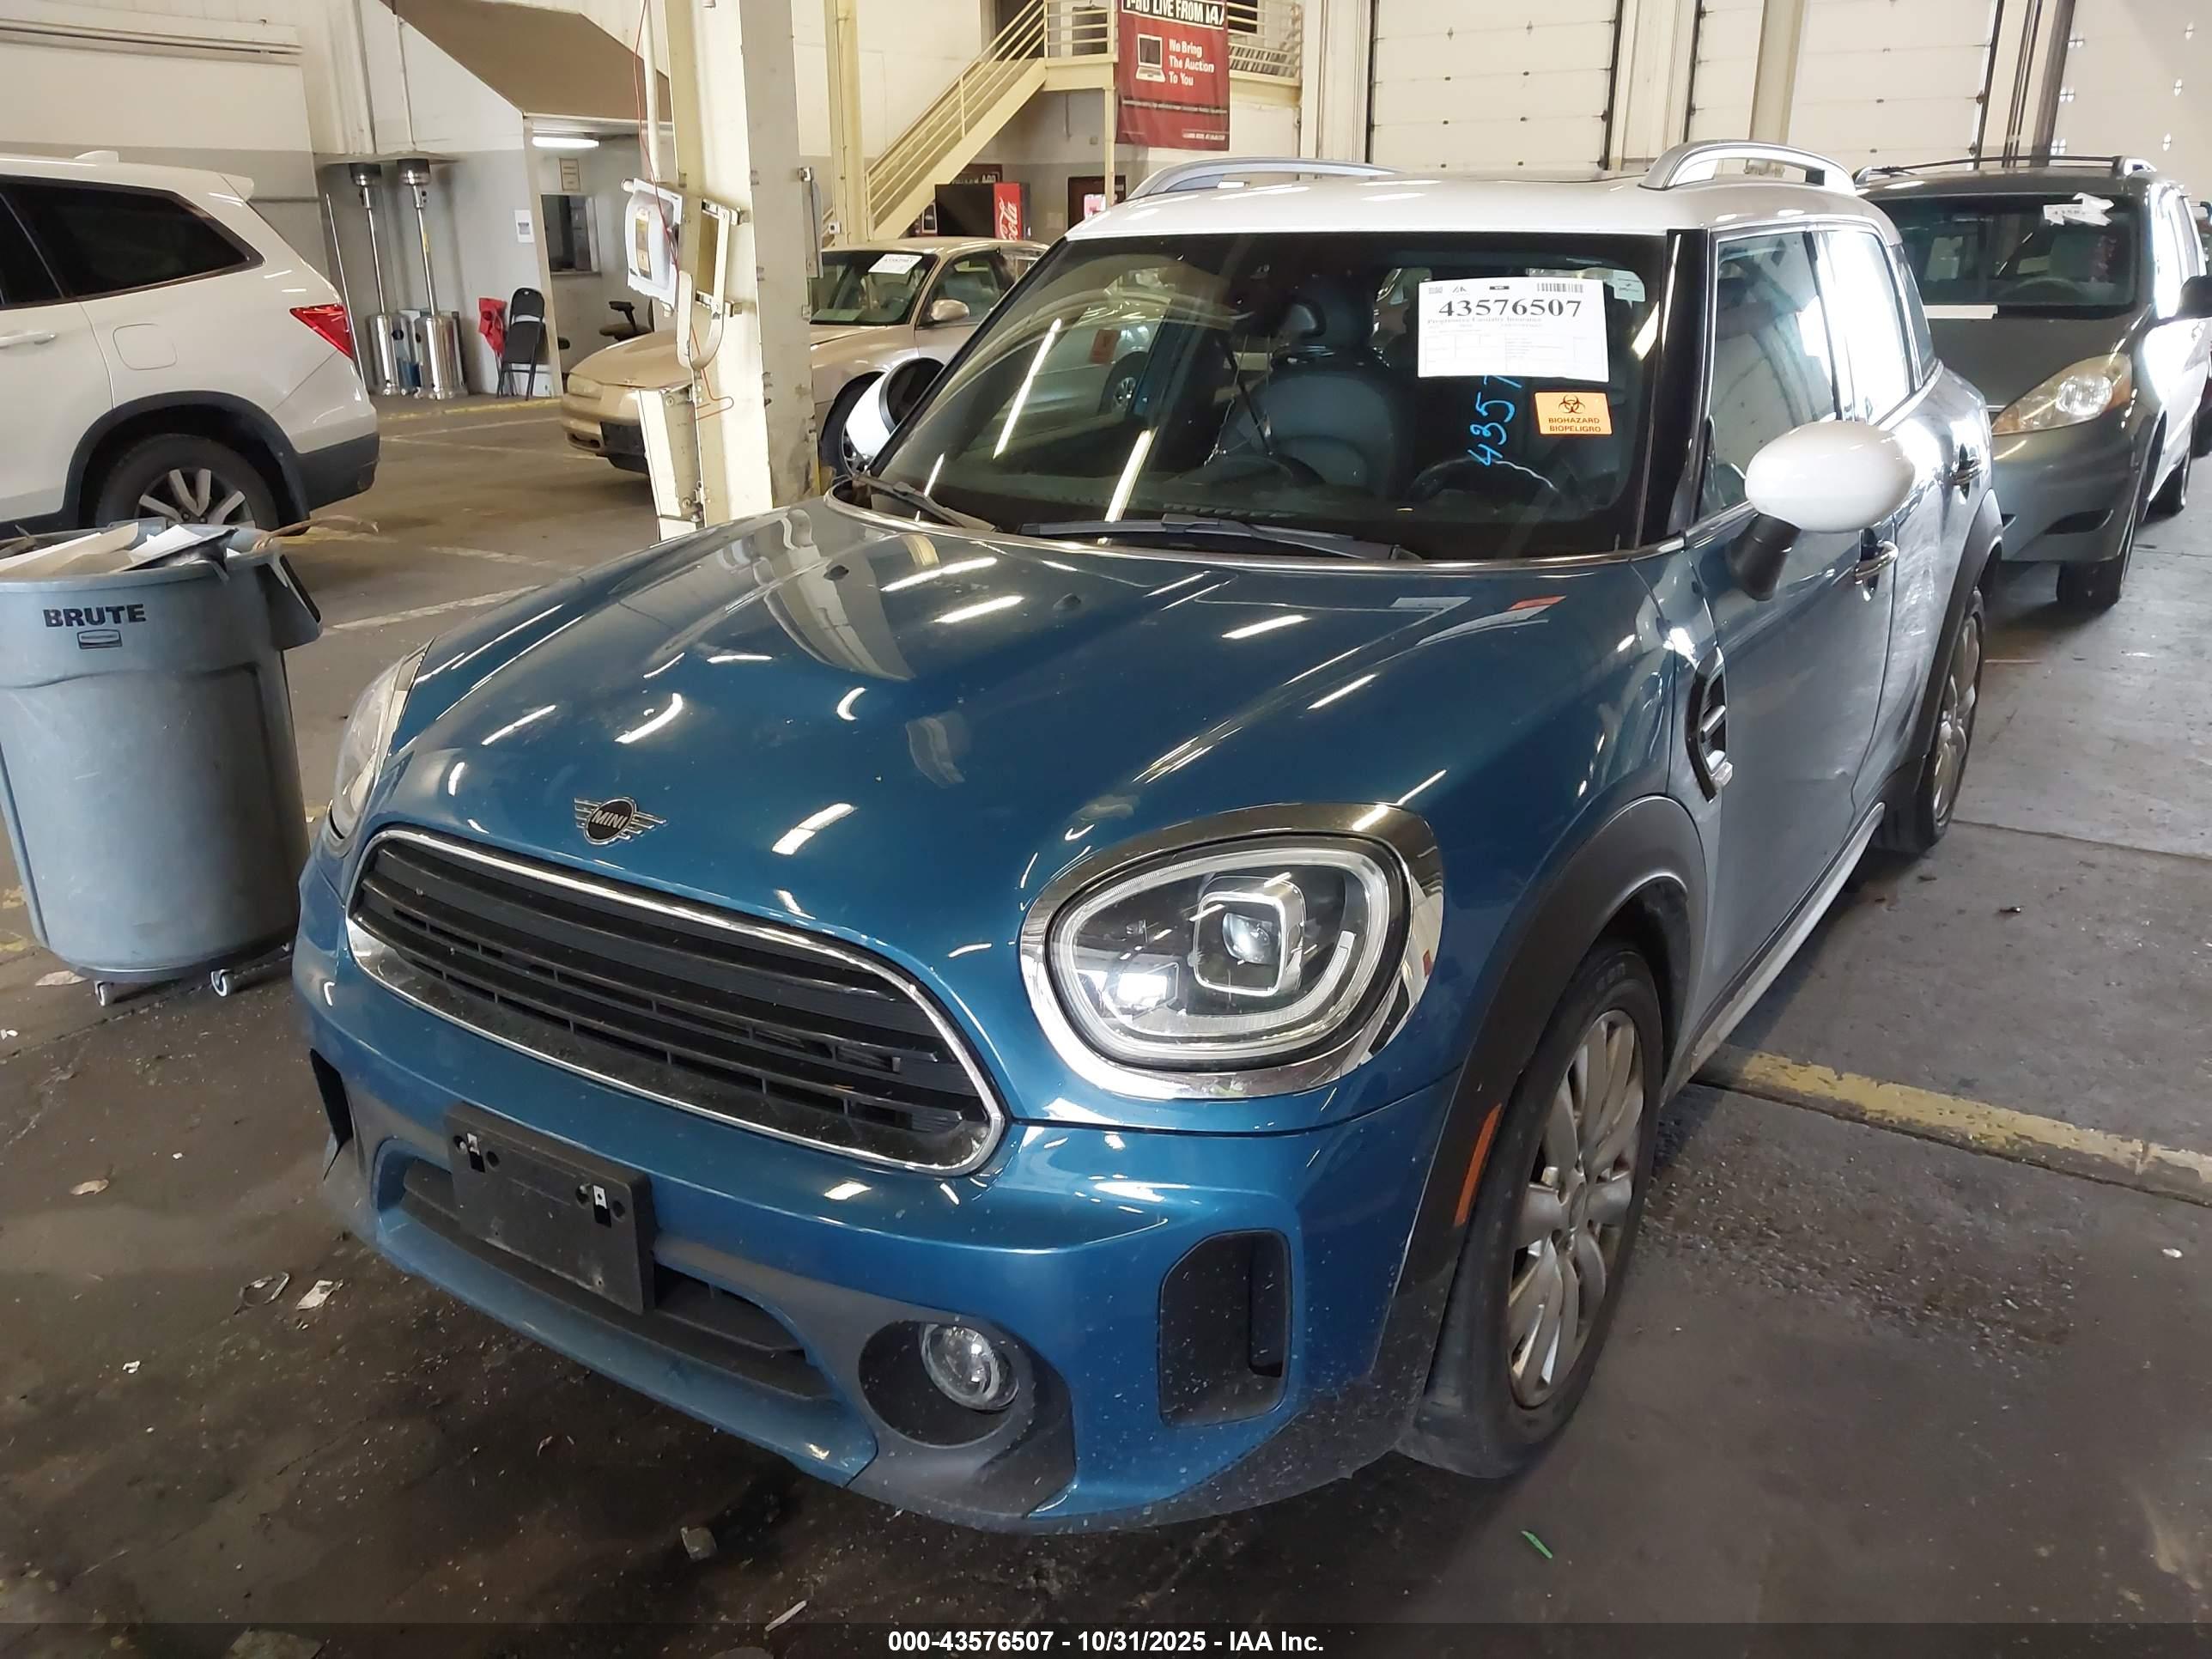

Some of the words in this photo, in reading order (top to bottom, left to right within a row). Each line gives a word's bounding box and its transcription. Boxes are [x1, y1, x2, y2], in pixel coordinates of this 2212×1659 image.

[1152, 0, 1174, 17] LIVE
[1176, 0, 1203, 22] FROM
[1169, 39, 1181, 52] We
[1182, 40, 1203, 58] Bring
[1169, 55, 1182, 69] The
[1184, 57, 1214, 73] Auction
[1169, 70, 1178, 84] To
[1180, 71, 1194, 86] You
[1438, 299, 1582, 317] 43576507
[43, 605, 146, 627] BRUTE
[592, 810, 628, 830] MINI
